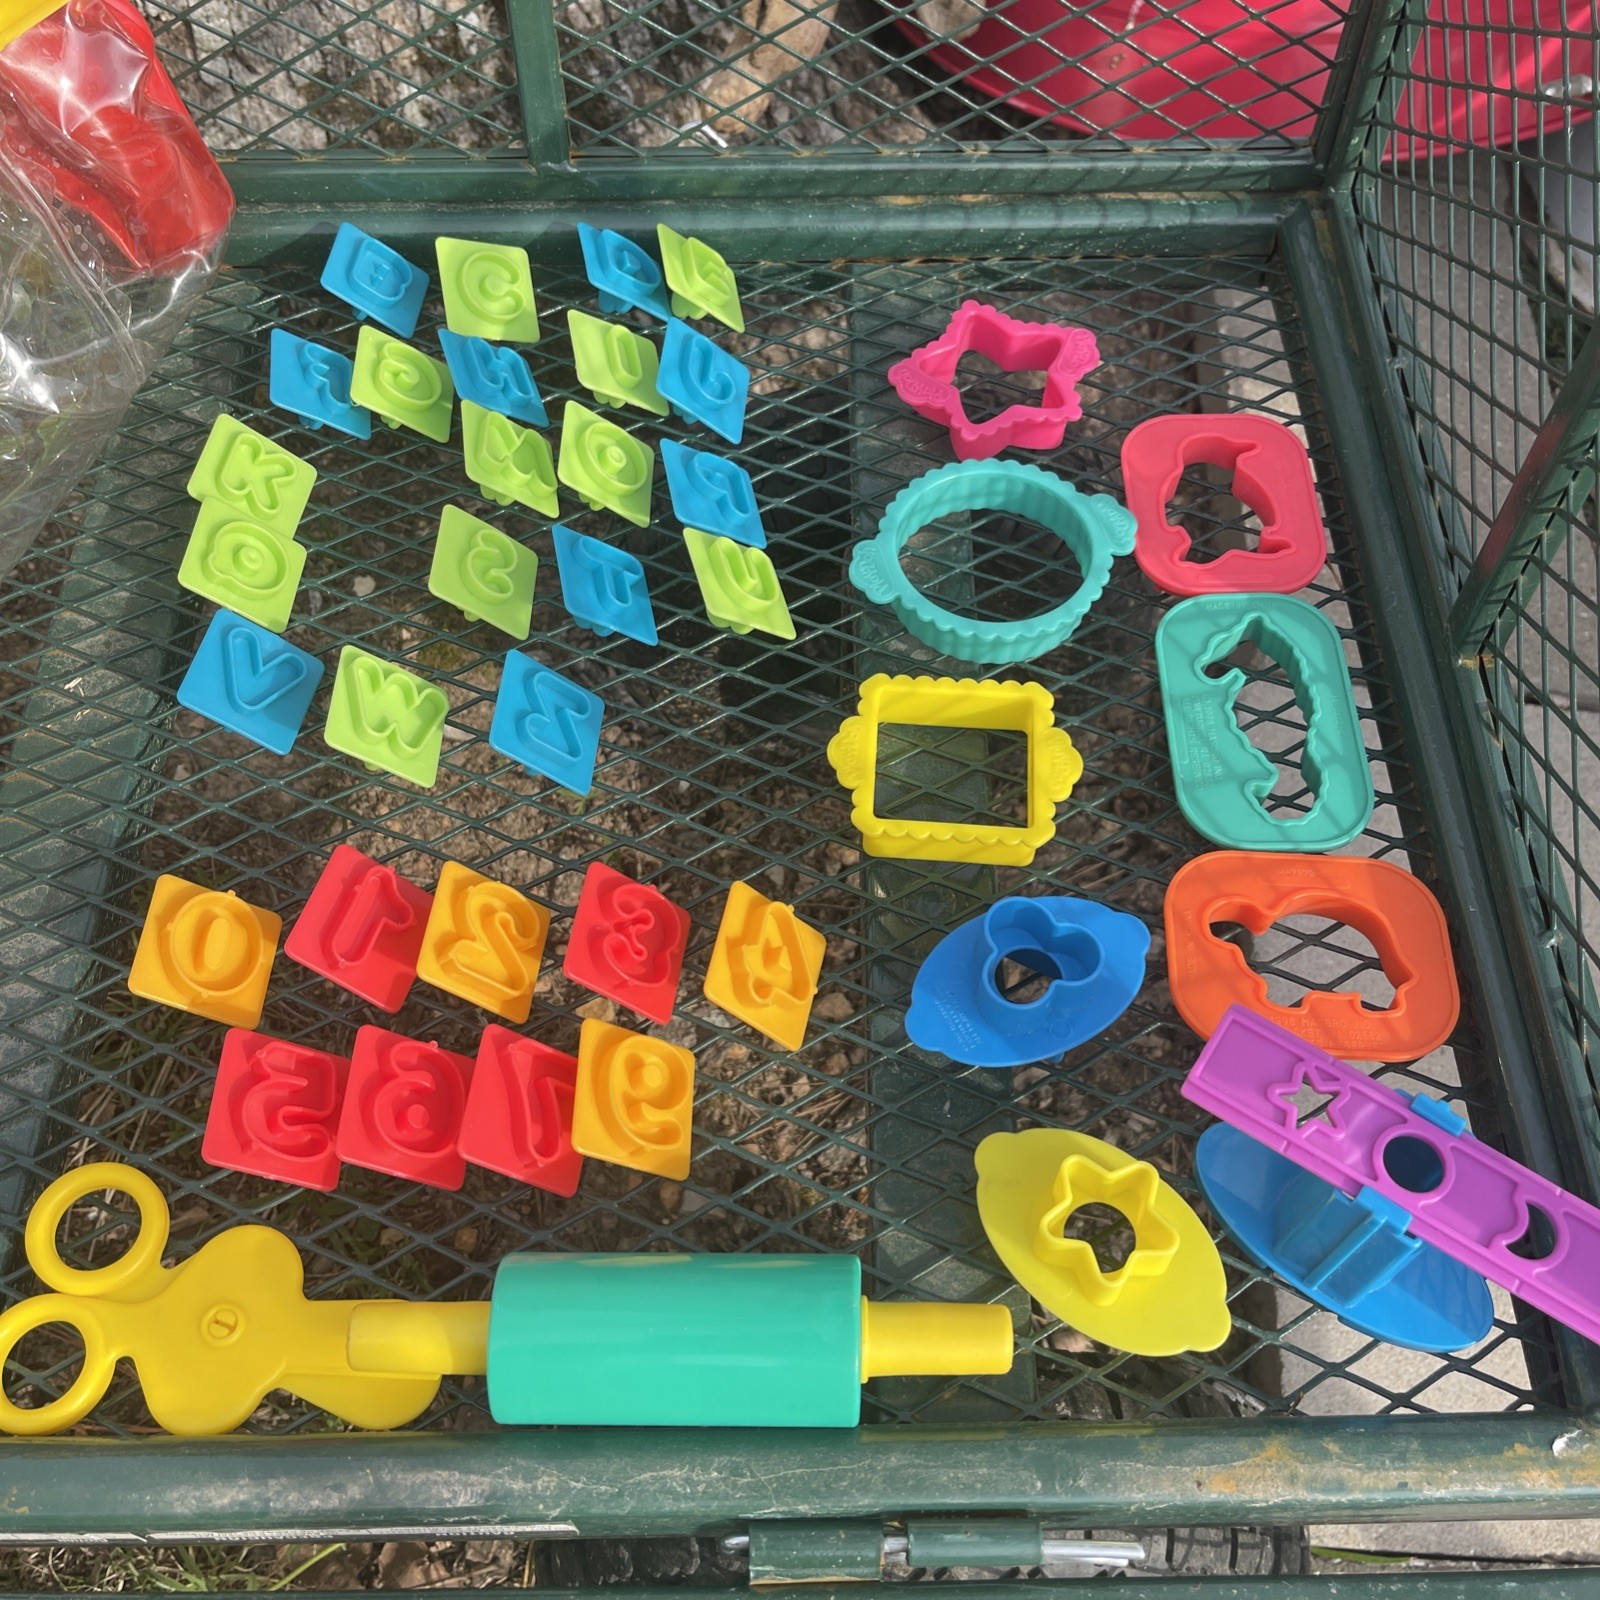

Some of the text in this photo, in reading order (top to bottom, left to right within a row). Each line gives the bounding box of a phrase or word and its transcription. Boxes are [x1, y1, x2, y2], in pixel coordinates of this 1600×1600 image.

[459, 251, 525, 321] C
[217, 432, 297, 516] K
[577, 534, 642, 608] T
[713, 536, 779, 607] U
[226, 626, 306, 711] V
[351, 656, 449, 753] W
